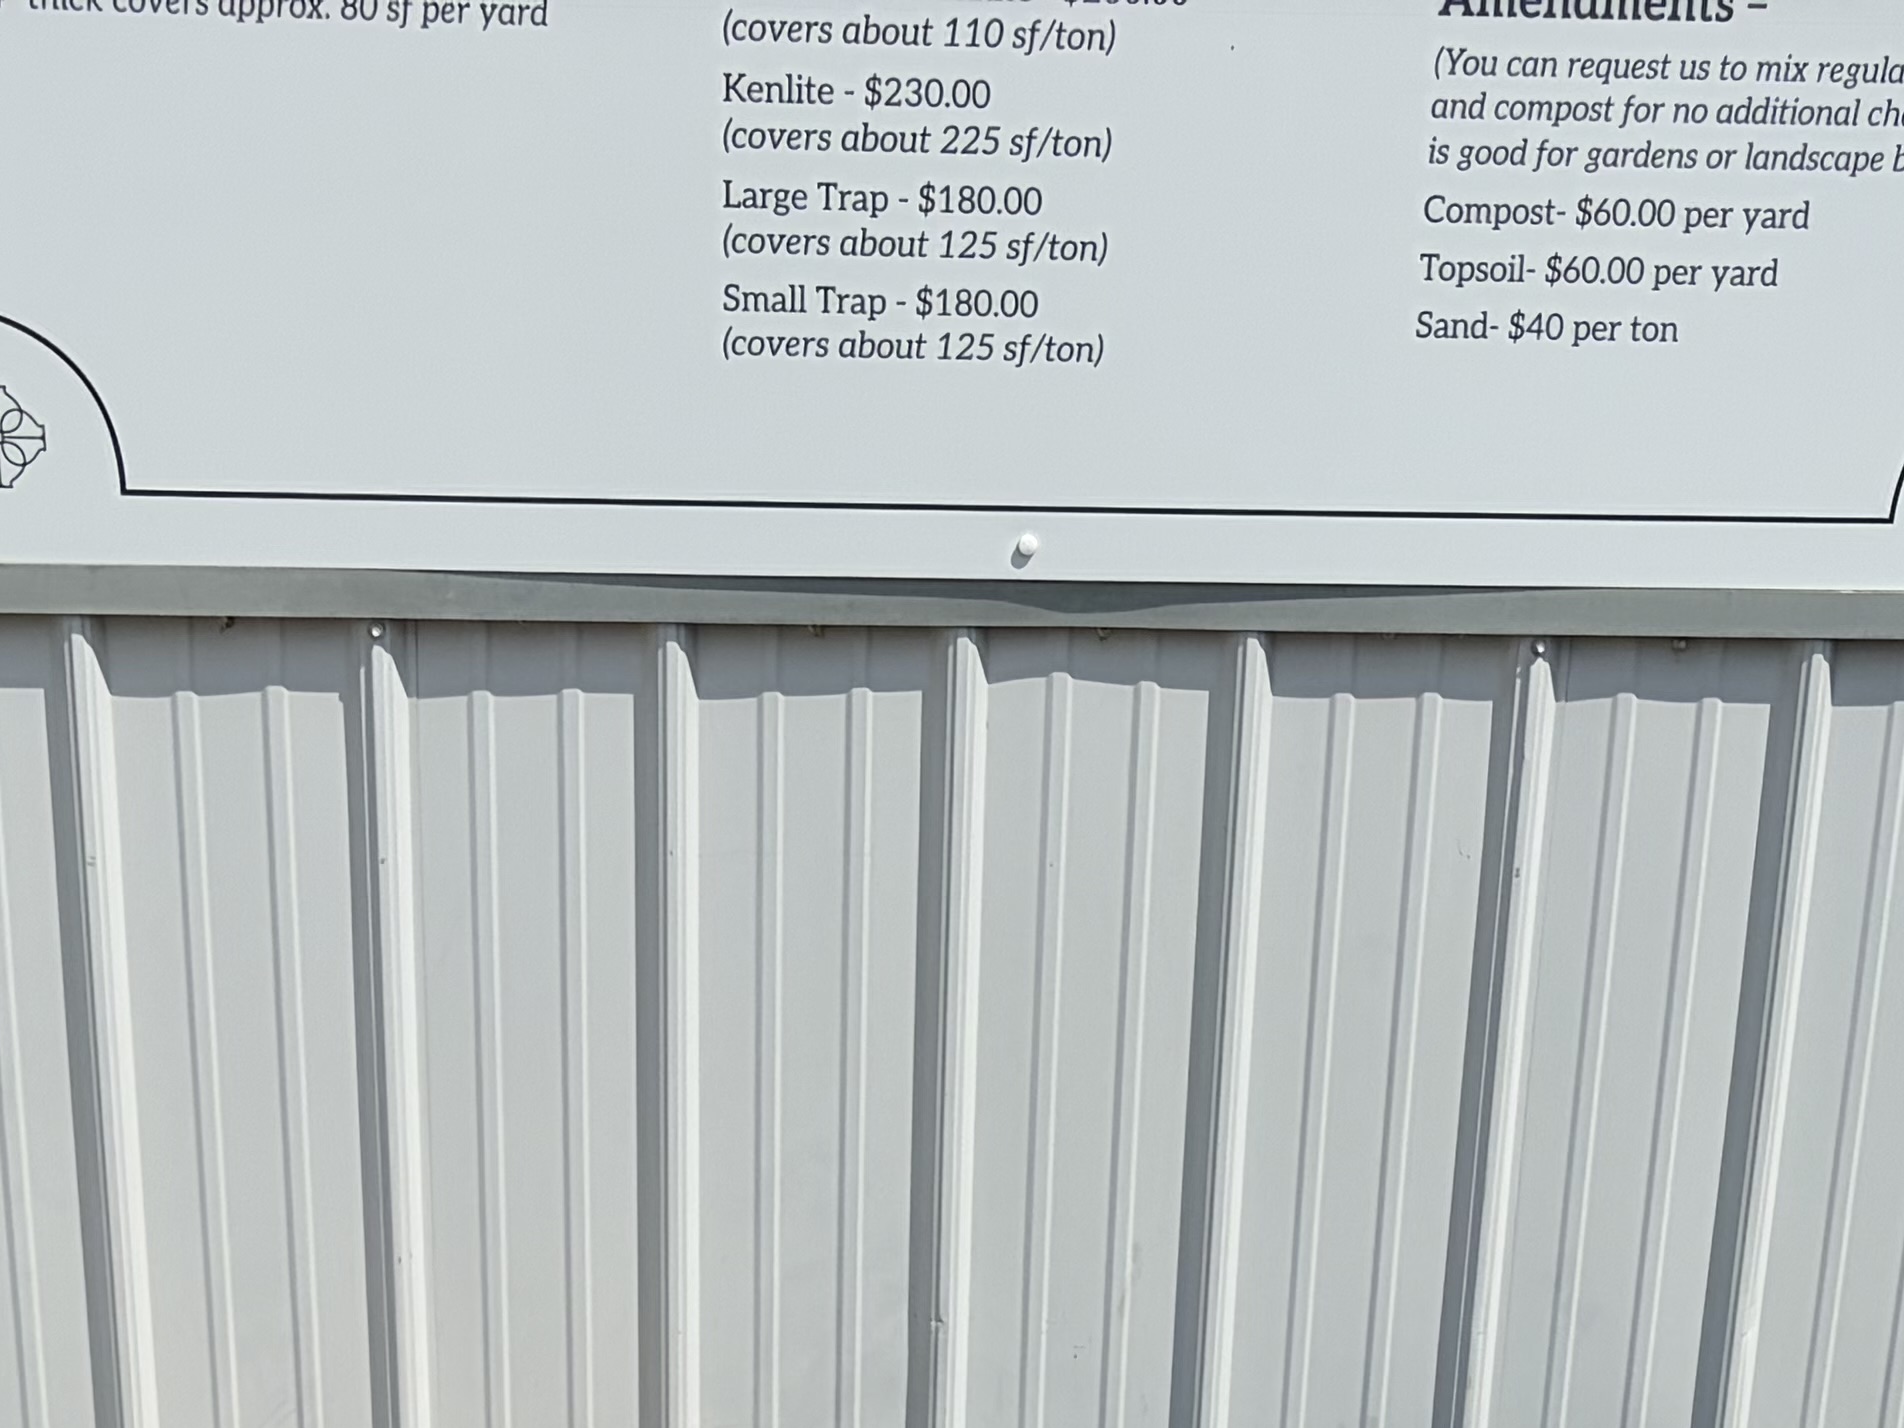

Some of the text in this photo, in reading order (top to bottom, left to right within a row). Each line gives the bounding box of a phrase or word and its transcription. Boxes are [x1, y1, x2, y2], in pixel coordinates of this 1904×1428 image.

[218, 0, 330, 24] approx.
[341, 0, 378, 21] 80
[387, 0, 413, 29] sf
[421, 0, 471, 29] per
[479, 0, 548, 31] yard
[723, 8, 1115, 56] (covers about 110 sf/ton)
[1435, 46, 1498, 80] (You
[1506, 56, 1557, 77] can
[1568, 54, 1672, 85] request
[1680, 60, 1711, 80] us
[1719, 55, 1747, 81] to
[1756, 54, 1809, 82] mix
[723, 72, 834, 105] Kenlite
[865, 73, 991, 111] $230.00
[1431, 91, 1487, 120] and
[1494, 96, 1615, 127] compost
[1618, 94, 1665, 129] for
[1673, 103, 1708, 124] no
[1716, 96, 1861, 126] additional
[723, 117, 1112, 163] (covers about 225 sf/ton)
[1429, 136, 1450, 164] is
[1456, 138, 1528, 171] good
[1532, 139, 1579, 172] for
[1584, 140, 1698, 173] gardens
[1706, 149, 1738, 169] or
[1745, 141, 1884, 177] landscape
[723, 179, 808, 216] Large
[817, 182, 888, 218] Trap
[918, 181, 1042, 218] $180.00
[1424, 194, 1810, 235] Compost- $60.00 per yard
[723, 222, 1107, 267] (covers about 125 sf/ton)
[1420, 252, 1778, 292] Topsoil- $60.00 per yard
[723, 283, 807, 313] Small
[816, 286, 886, 321] Trap
[916, 284, 1038, 320] $180.00
[723, 325, 1104, 368] (covers about 125 sf/ton)
[1416, 308, 1678, 347] Sand- $40 per ton
